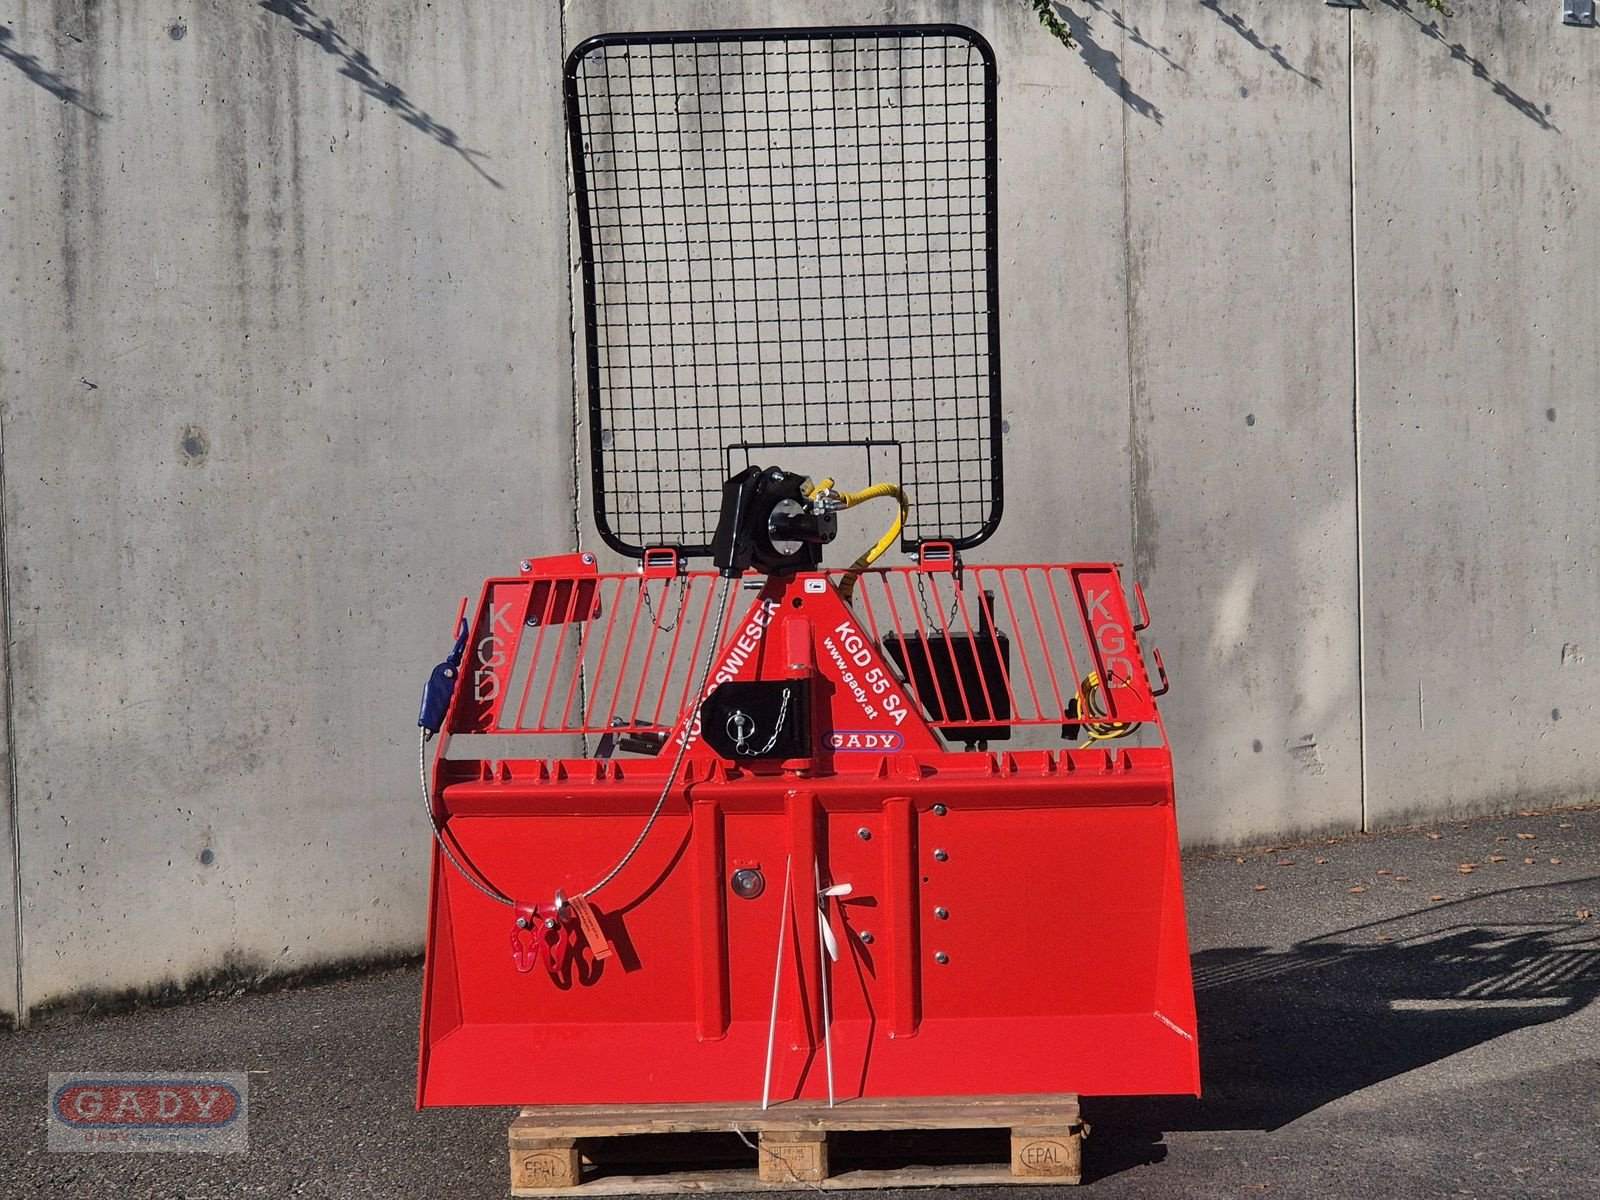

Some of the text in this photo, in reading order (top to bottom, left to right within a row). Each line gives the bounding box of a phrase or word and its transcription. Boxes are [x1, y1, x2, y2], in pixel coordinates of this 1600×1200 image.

[474, 603, 514, 701] KGD
[823, 636, 879, 720] www.gady.at
[834, 621, 908, 726] KGD 55 SA
[1086, 589, 1133, 689] KGD
[830, 734, 895, 748] GADY
[1027, 1147, 1062, 1164] EPAL
